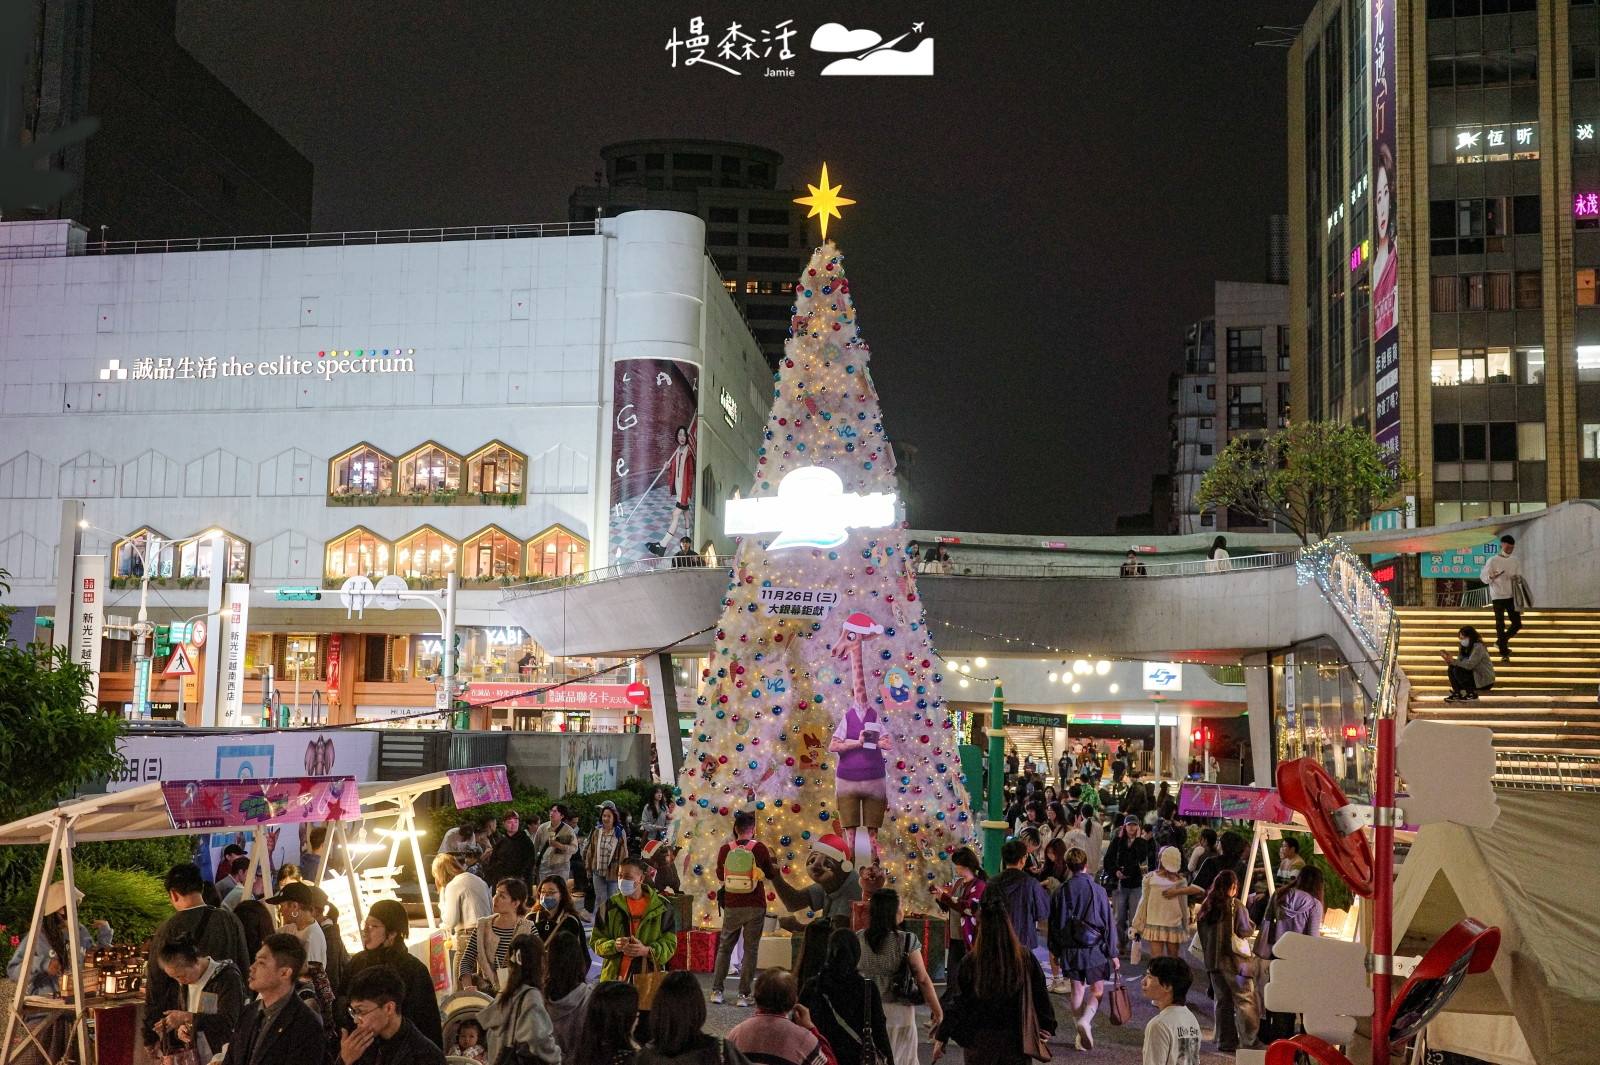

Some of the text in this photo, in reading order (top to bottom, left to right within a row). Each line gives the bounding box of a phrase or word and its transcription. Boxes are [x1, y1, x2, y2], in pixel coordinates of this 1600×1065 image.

[132, 354, 415, 381] 誠品生活 the eslite spectrum
[760, 590, 838, 604] 11月26日(三)
[768, 604, 825, 617] 大銀幕鉅獻
[80, 612, 94, 690] 新光三越南
[226, 631, 240, 701] 新光三越南西店
[225, 710, 234, 718] 6F
